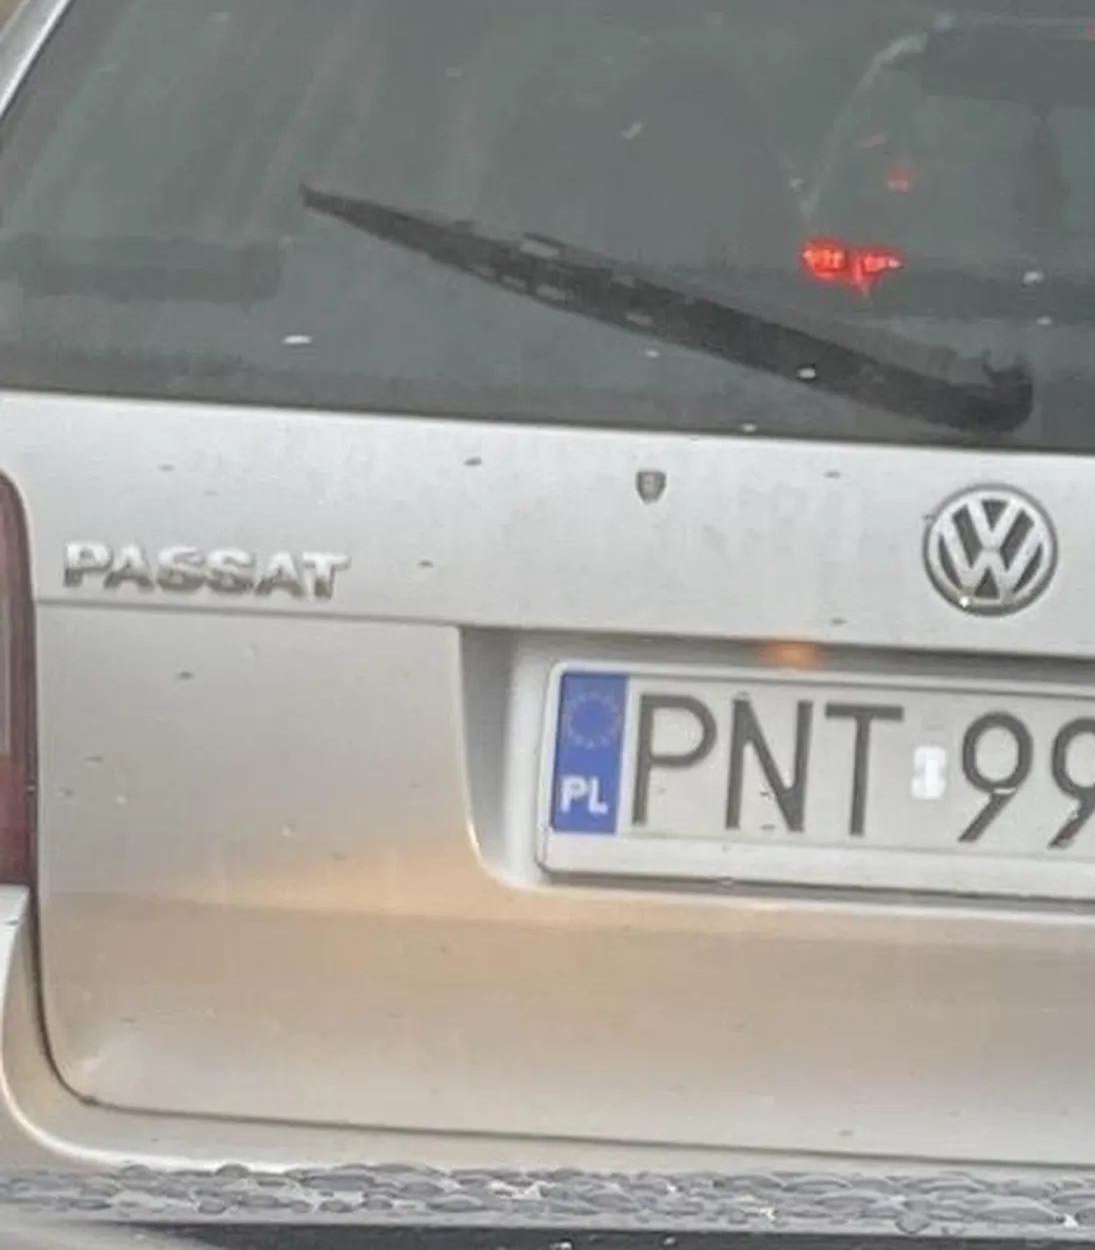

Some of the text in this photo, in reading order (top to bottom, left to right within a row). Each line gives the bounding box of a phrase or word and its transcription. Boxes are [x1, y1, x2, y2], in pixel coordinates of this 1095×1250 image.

[63, 540, 350, 600] PASSAT
[929, 489, 1053, 611] VW
[559, 776, 608, 815] PL
[631, 692, 904, 837] PNT
